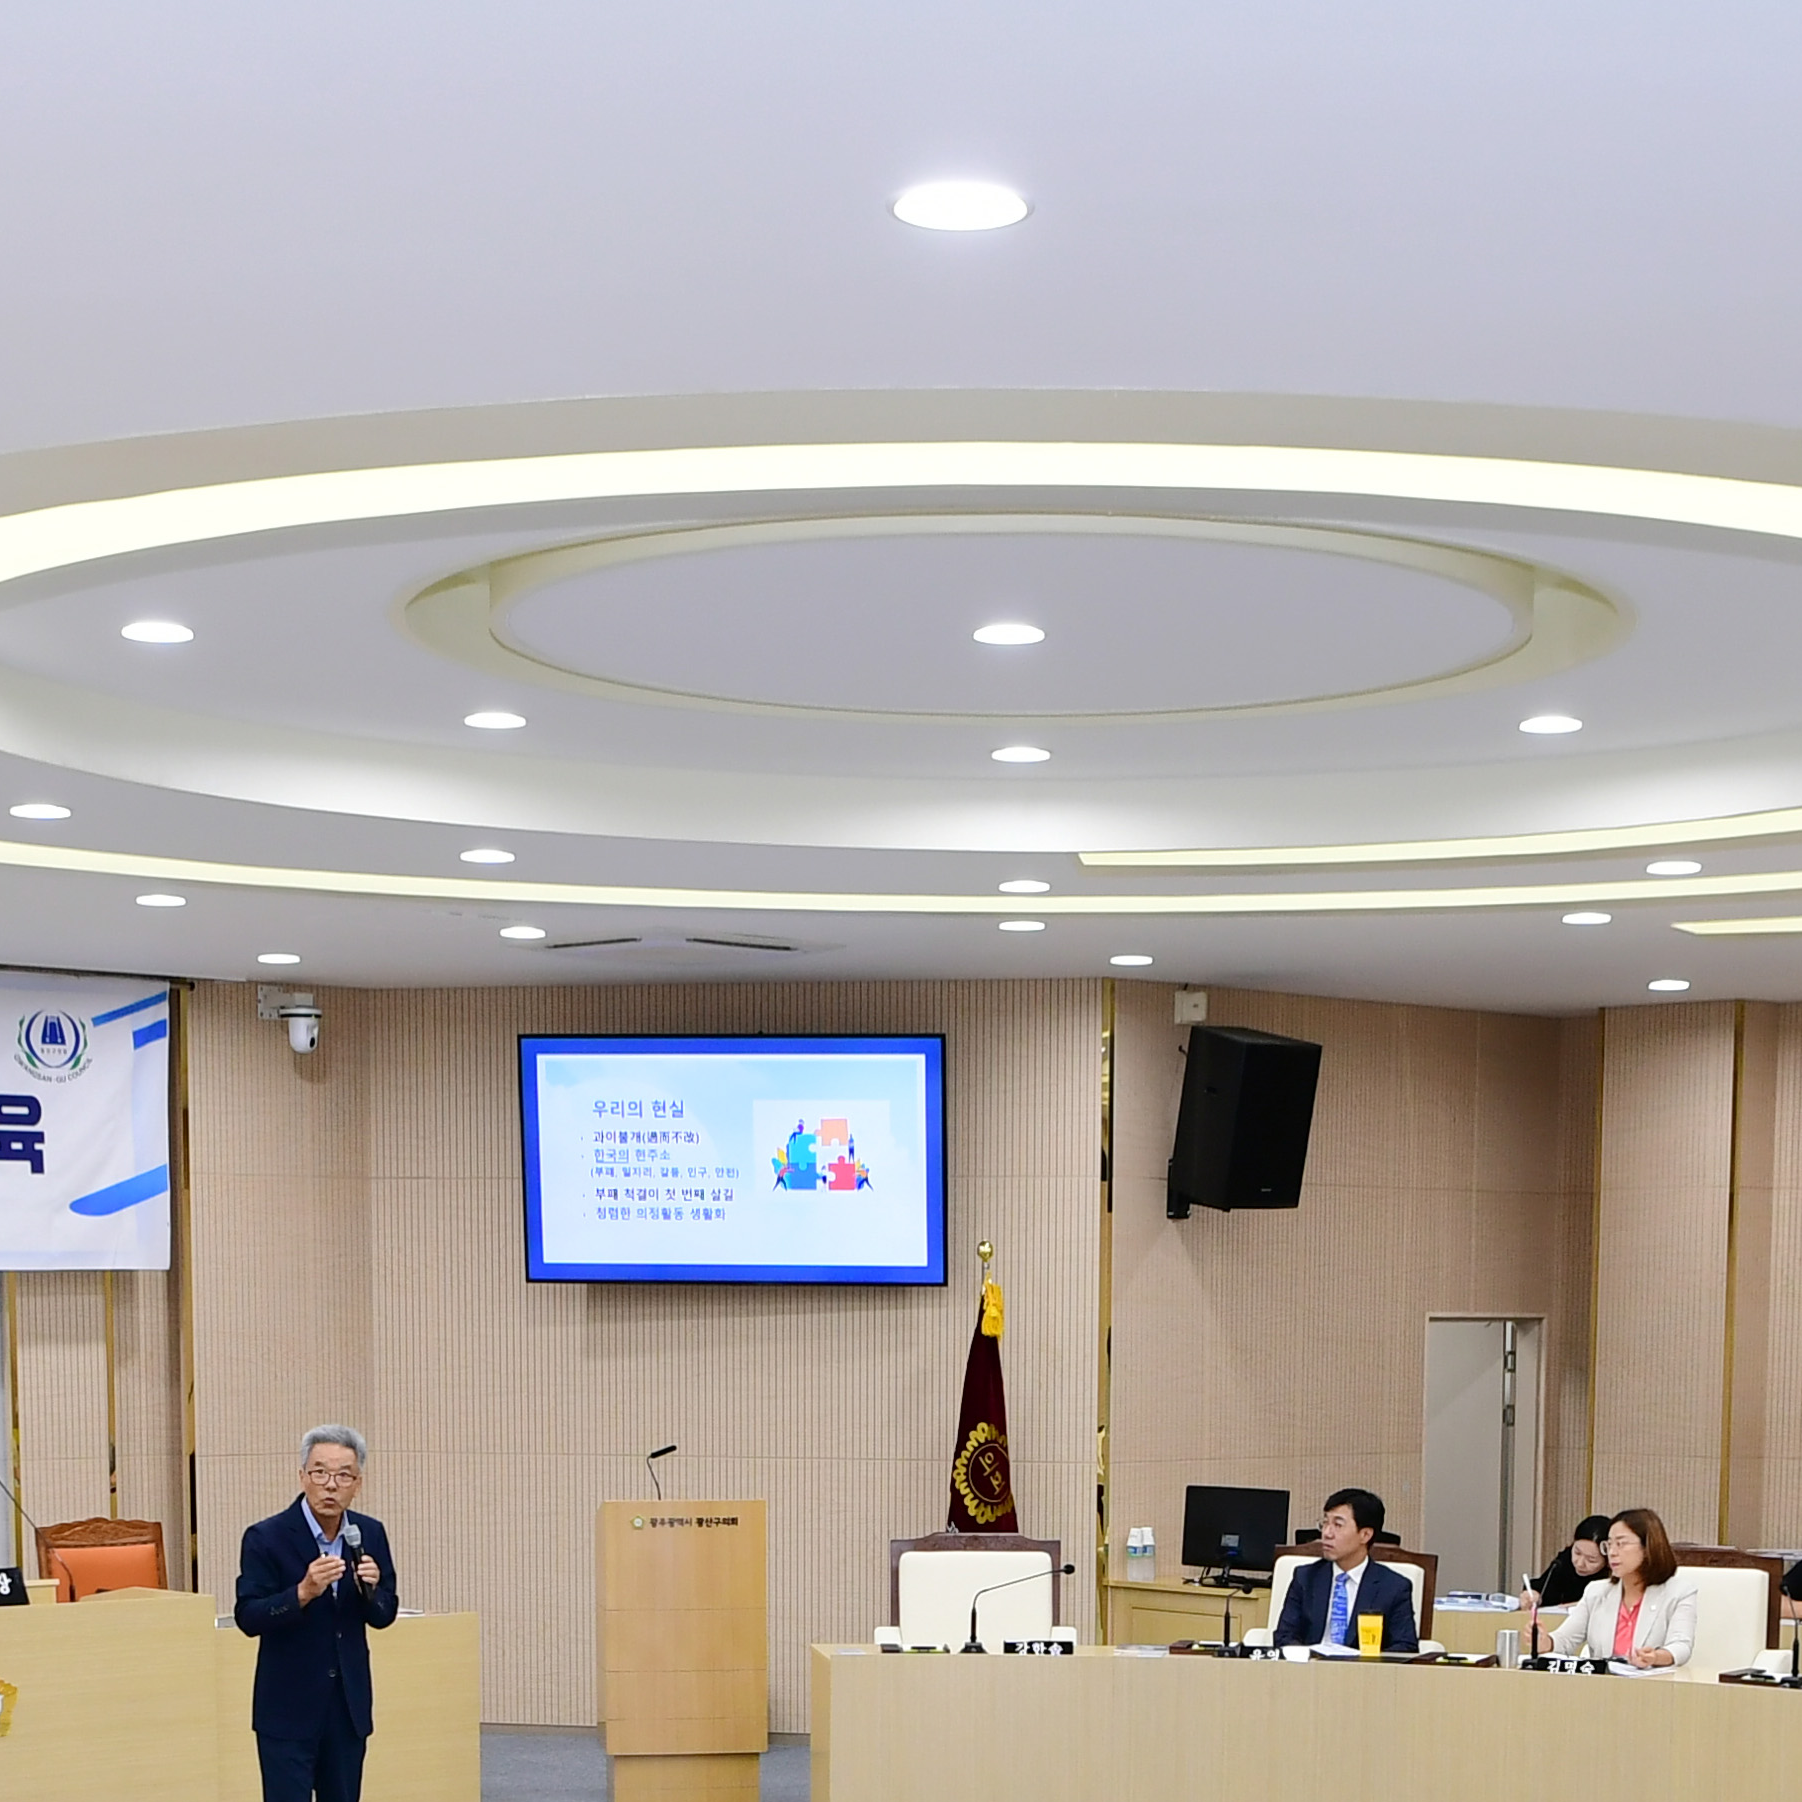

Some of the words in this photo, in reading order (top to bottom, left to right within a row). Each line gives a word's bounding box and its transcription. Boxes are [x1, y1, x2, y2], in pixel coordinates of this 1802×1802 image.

[592, 1100, 643, 1118] 우리의
[651, 1100, 685, 1118] 현실
[594, 1149, 629, 1163] 한국의
[635, 1149, 671, 1162] 현주소
[595, 1188, 618, 1202] 부패
[624, 1188, 659, 1202] 척결이
[665, 1188, 676, 1201] 첫
[681, 1188, 705, 1202] 번째
[596, 1207, 631, 1221] 청렴한
[636, 1207, 684, 1221] 의정활동
[690, 1207, 726, 1221] 생활화
[696, 1517, 738, 1528] 광산구의회
